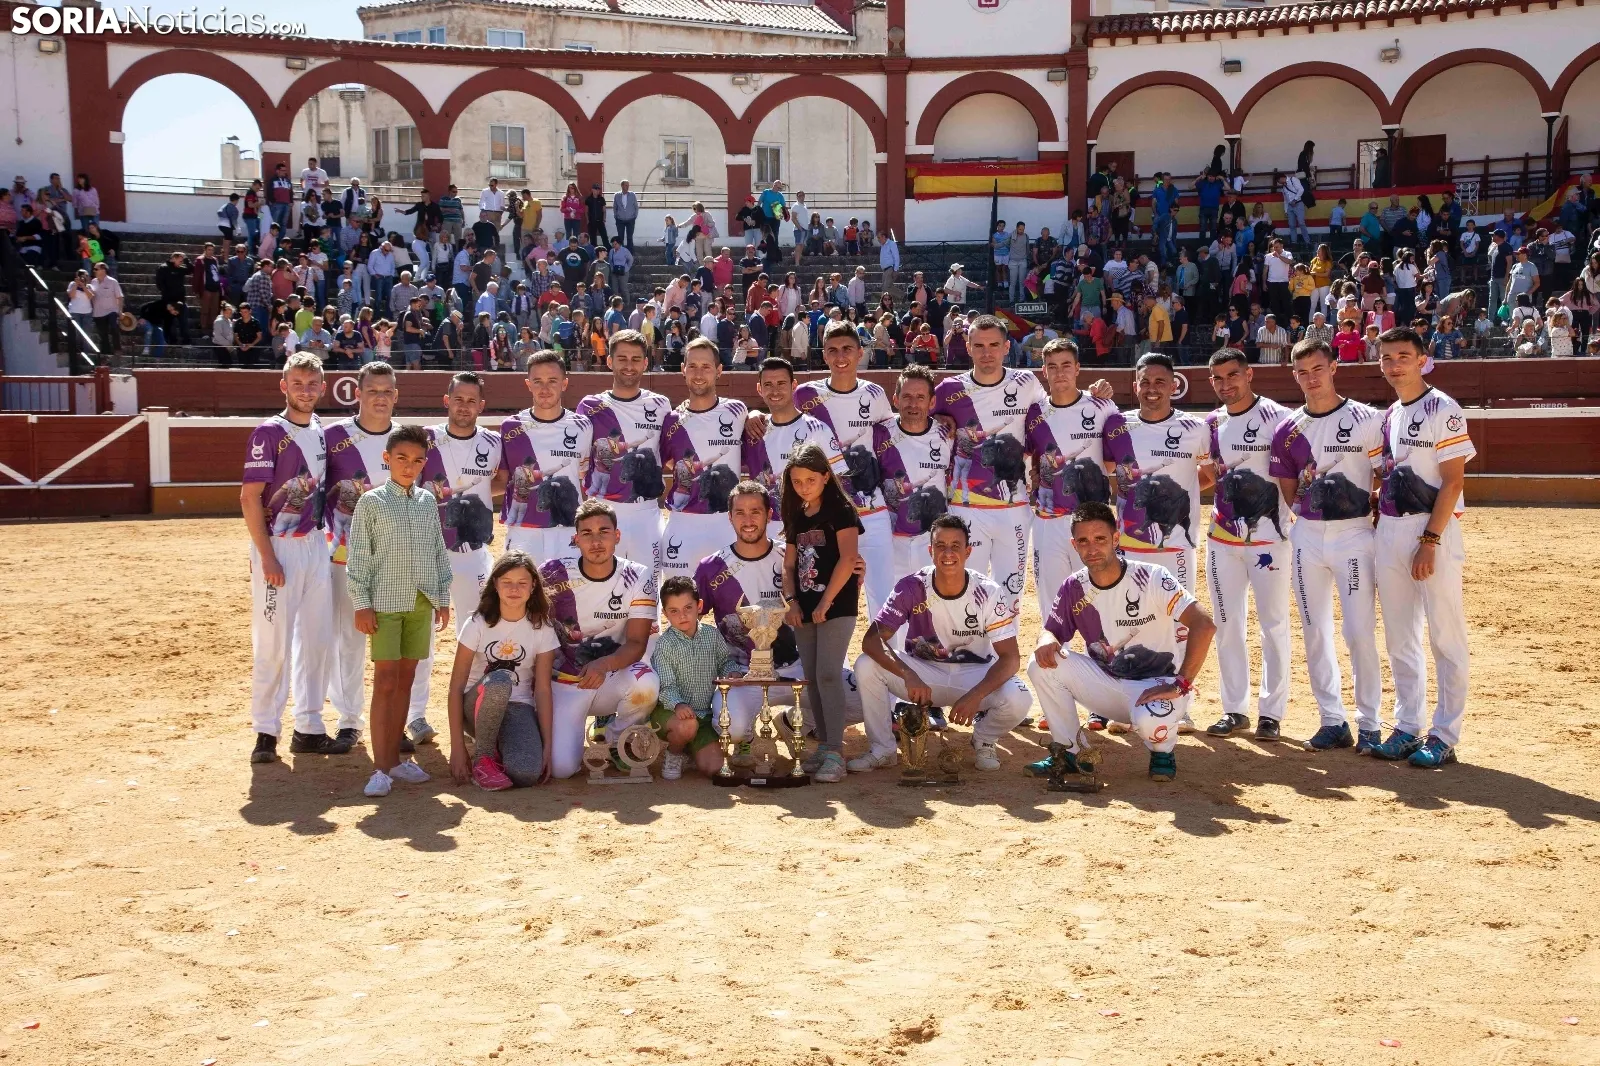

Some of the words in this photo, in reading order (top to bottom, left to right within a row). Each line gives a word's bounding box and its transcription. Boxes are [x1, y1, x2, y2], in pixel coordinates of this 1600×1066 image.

[1018, 304, 1044, 312] SALIDA
[342, 382, 351, 400] 1
[1150, 449, 1193, 458] TAUROEMOCIÓN
